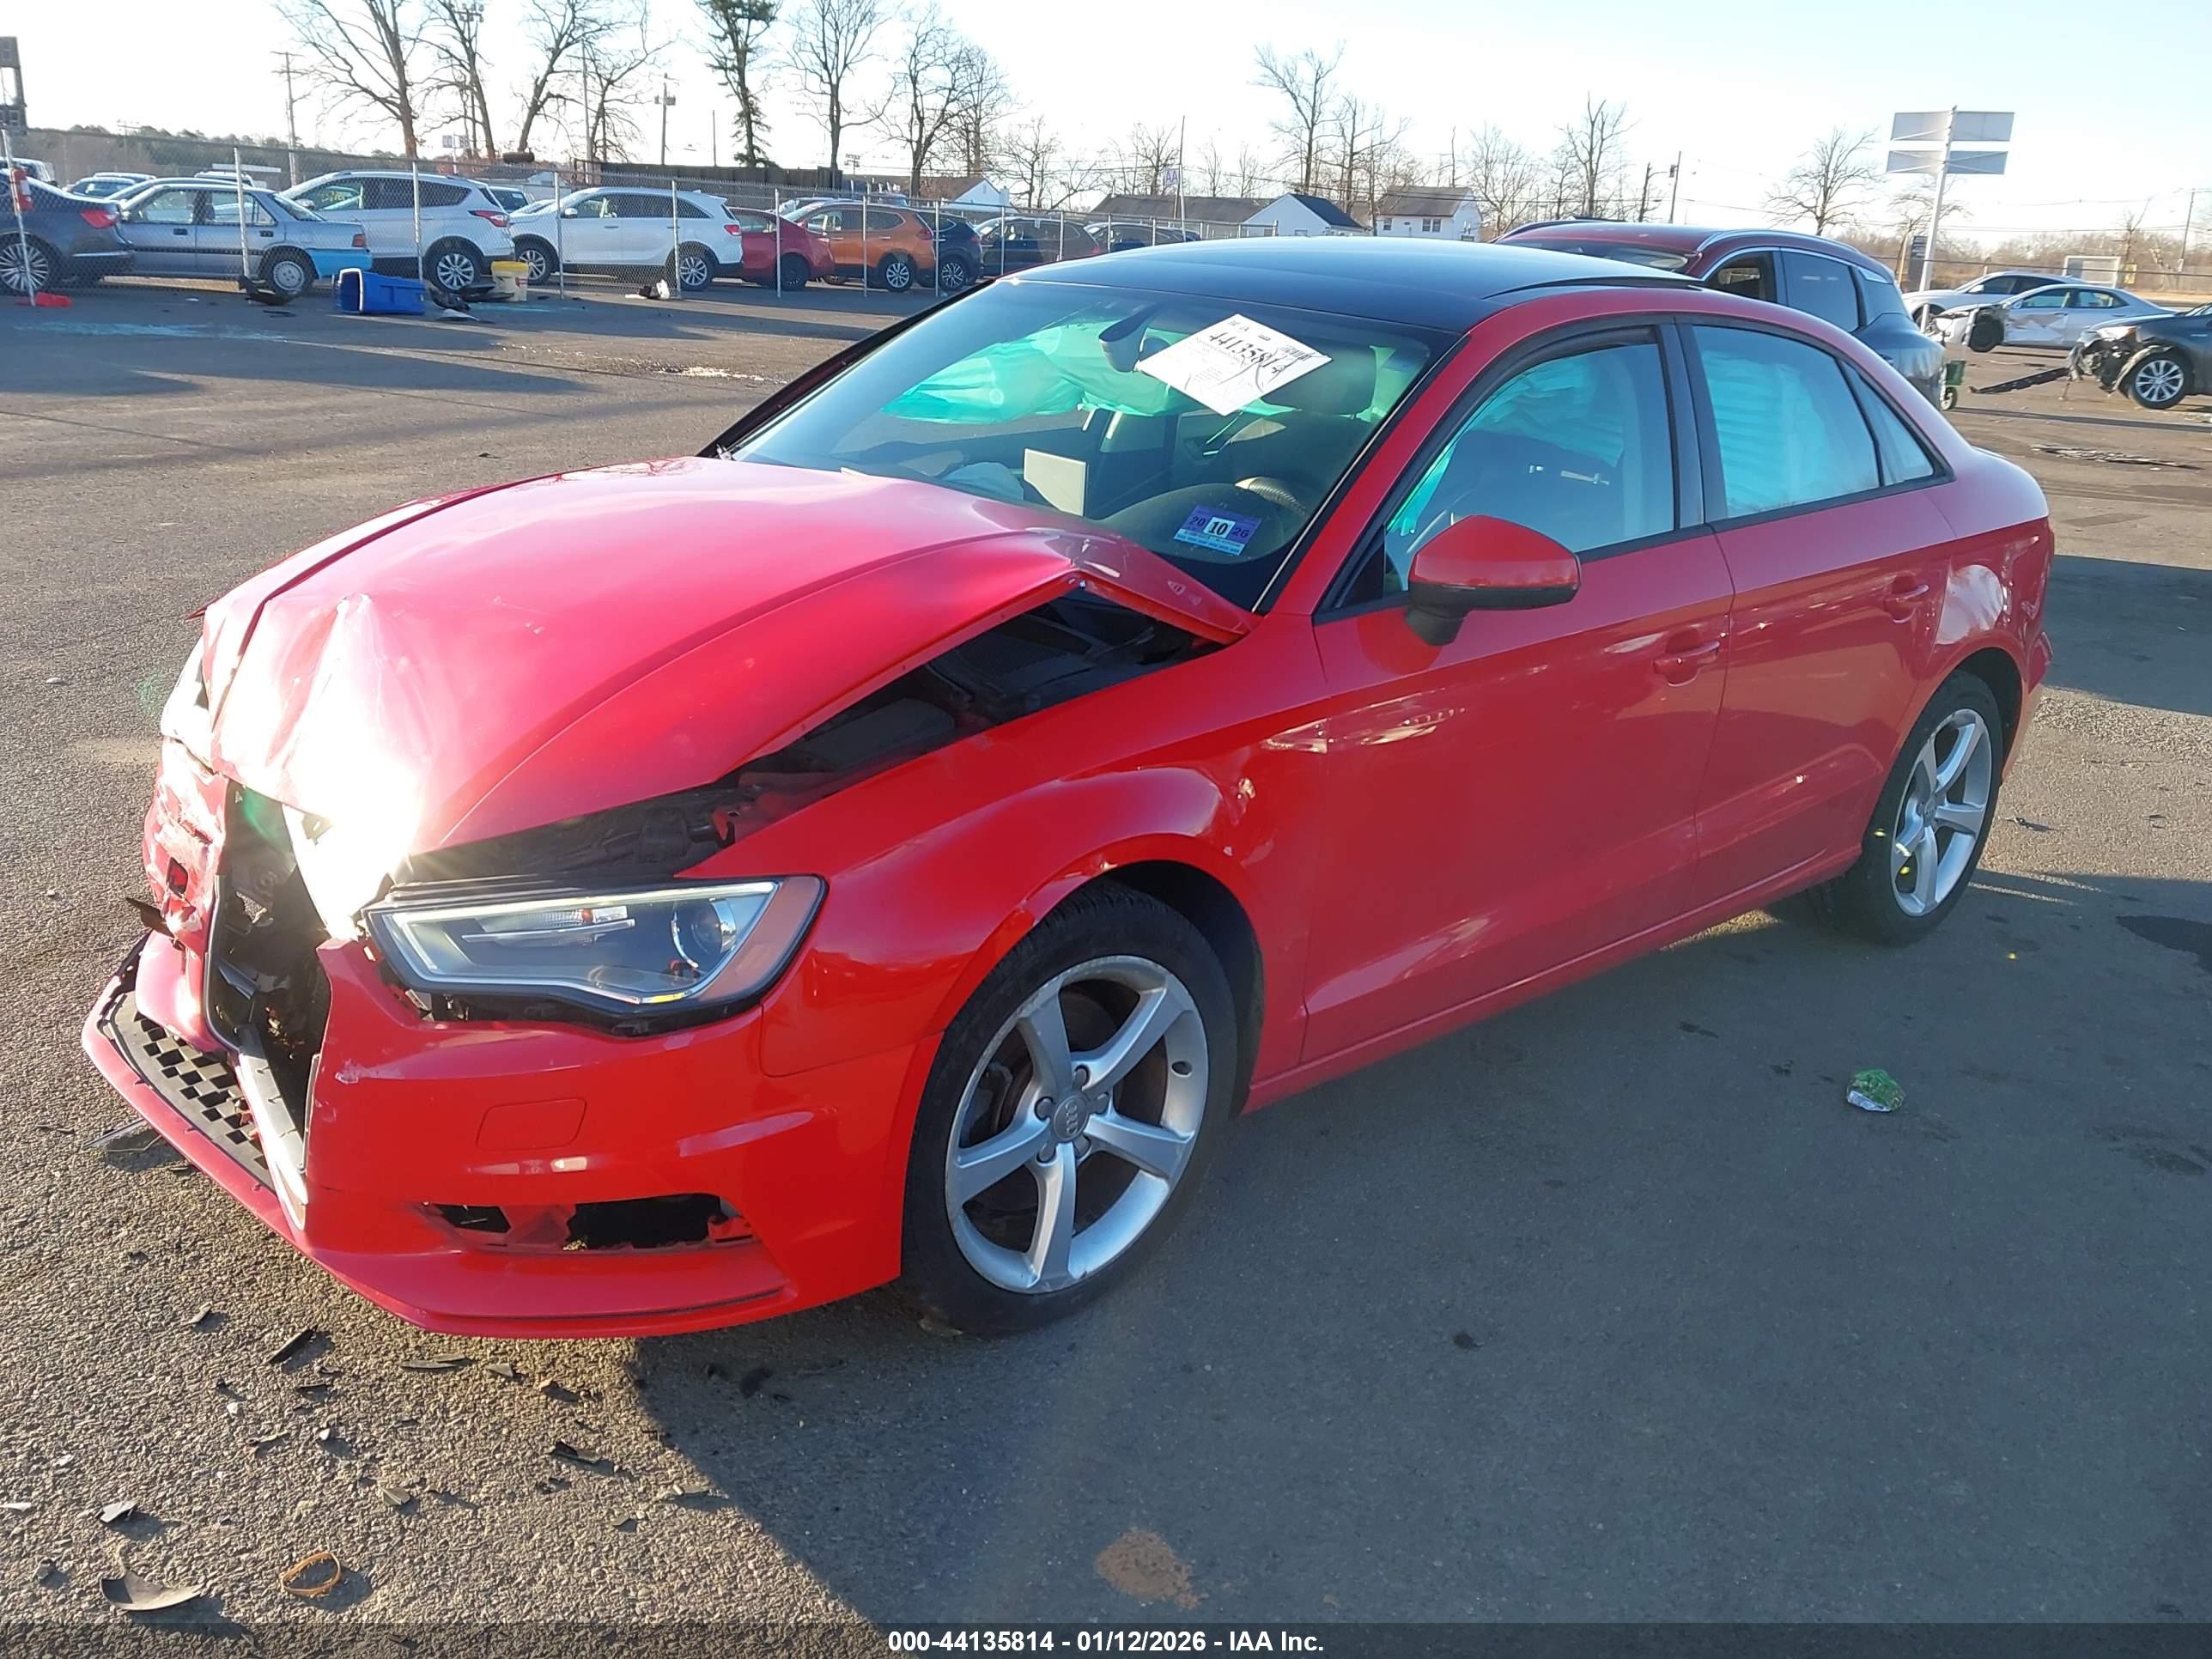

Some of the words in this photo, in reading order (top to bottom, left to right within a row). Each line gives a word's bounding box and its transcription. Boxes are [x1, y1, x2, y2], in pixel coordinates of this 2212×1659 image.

[1209, 331, 1298, 374] 44135814
[1189, 516, 1206, 526] 20
[1208, 521, 1229, 536] 10
[1232, 529, 1249, 538] 26
